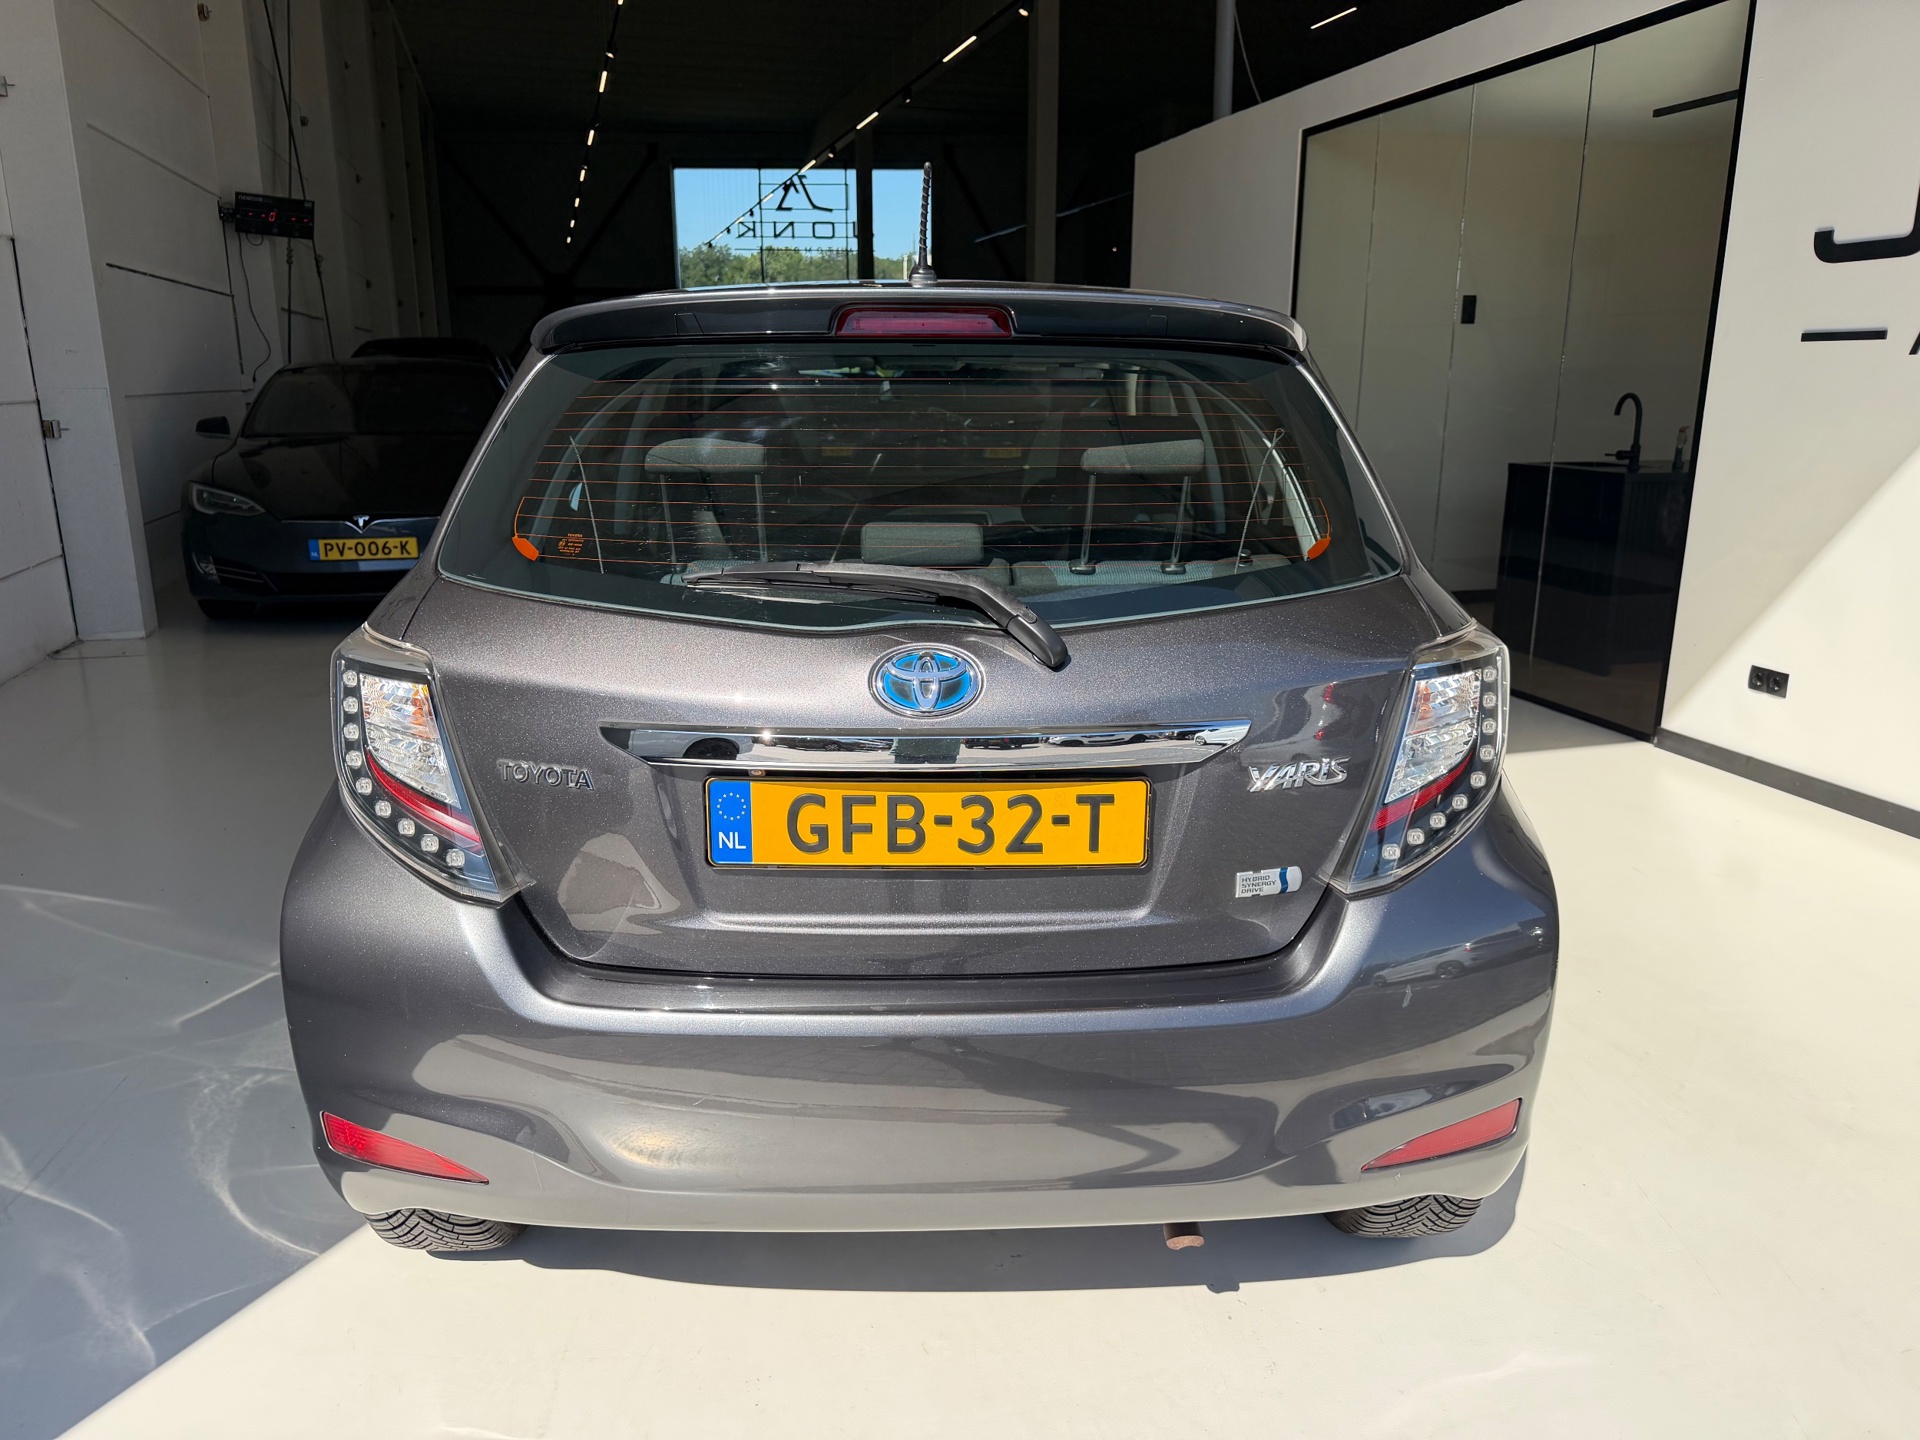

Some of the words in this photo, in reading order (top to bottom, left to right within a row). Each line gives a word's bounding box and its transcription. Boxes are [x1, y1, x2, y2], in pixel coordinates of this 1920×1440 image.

[324, 541, 411, 557] PV-006-K
[498, 761, 594, 790] TOYOTA
[786, 793, 1115, 855] GFB-32-T
[718, 832, 746, 850] NL
[1241, 875, 1270, 883] HYBRID
[1241, 880, 1277, 888] SYNERGY
